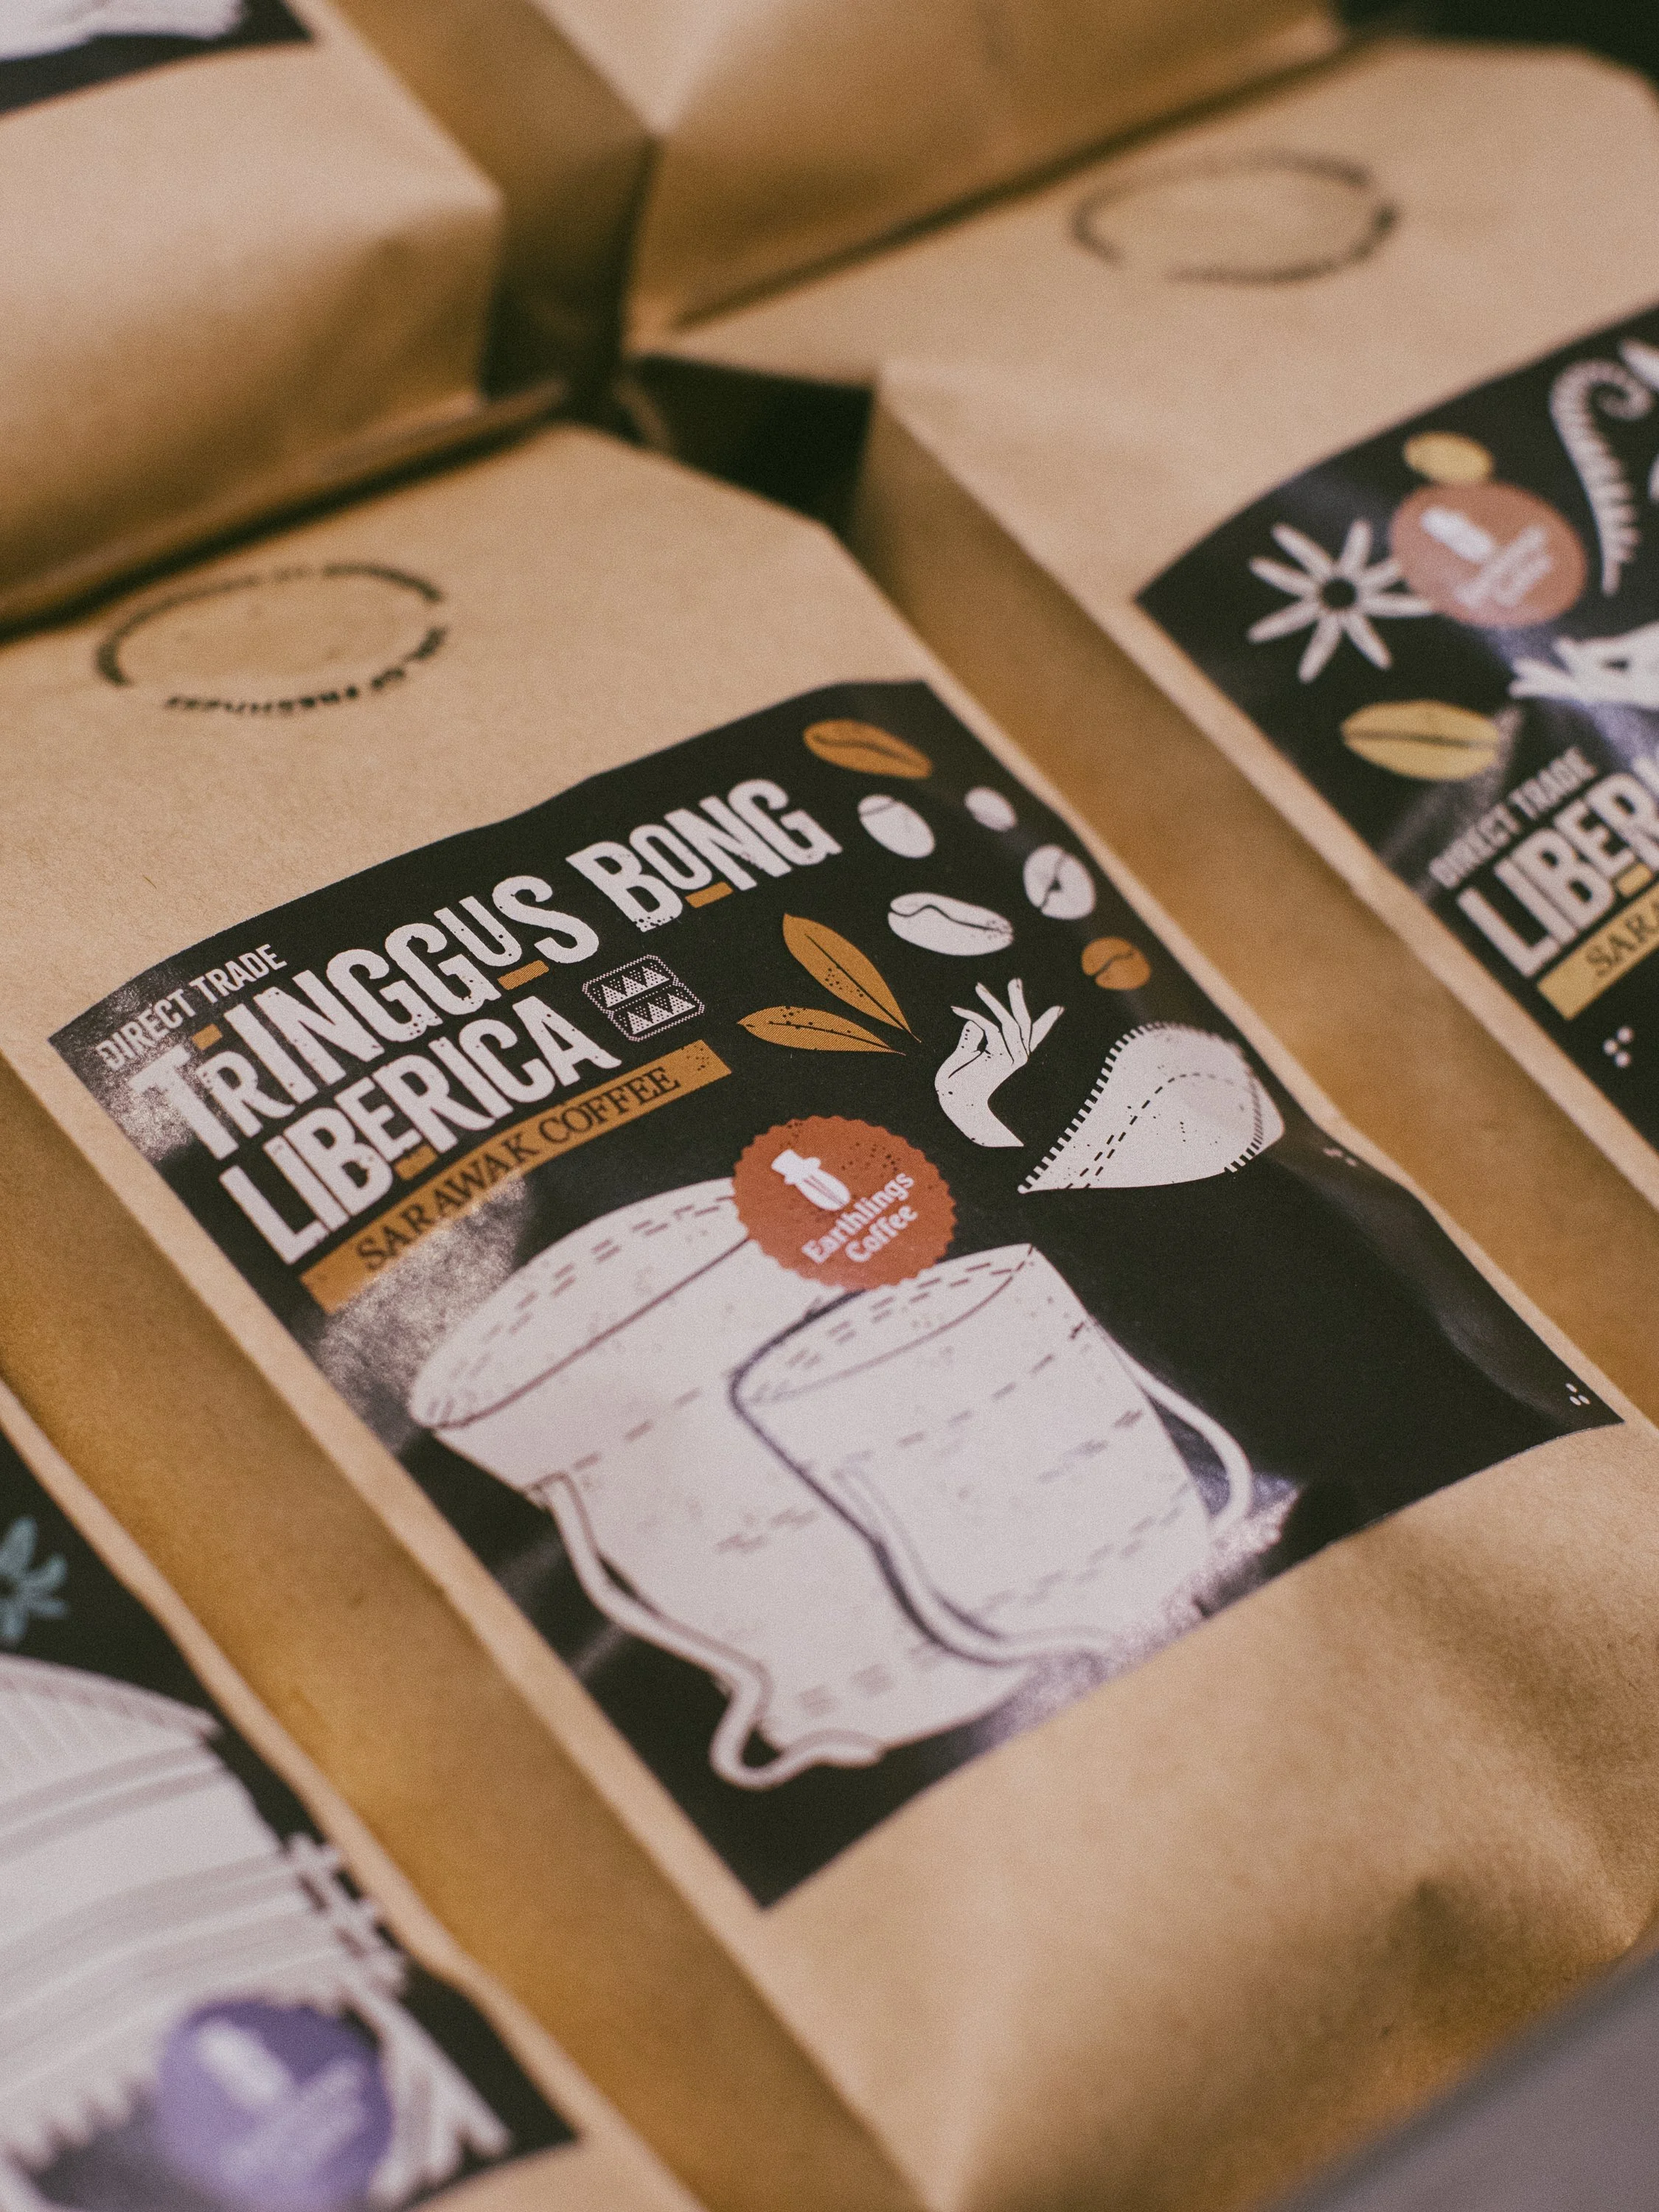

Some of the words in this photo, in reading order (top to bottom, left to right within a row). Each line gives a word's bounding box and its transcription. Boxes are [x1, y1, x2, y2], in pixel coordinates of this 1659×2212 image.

[566, 779, 842, 933] BONG
[1585, 901, 1659, 978] SAR
[95, 988, 196, 1069] DIRECT
[189, 944, 288, 1004] TRADE
[218, 995, 622, 1265] LIBERICA
[356, 1133, 542, 1272] SARAWAK
[538, 1066, 681, 1145] COFFEE
[801, 1173, 915, 1264] Earthlings
[846, 1206, 918, 1263] Coffee
